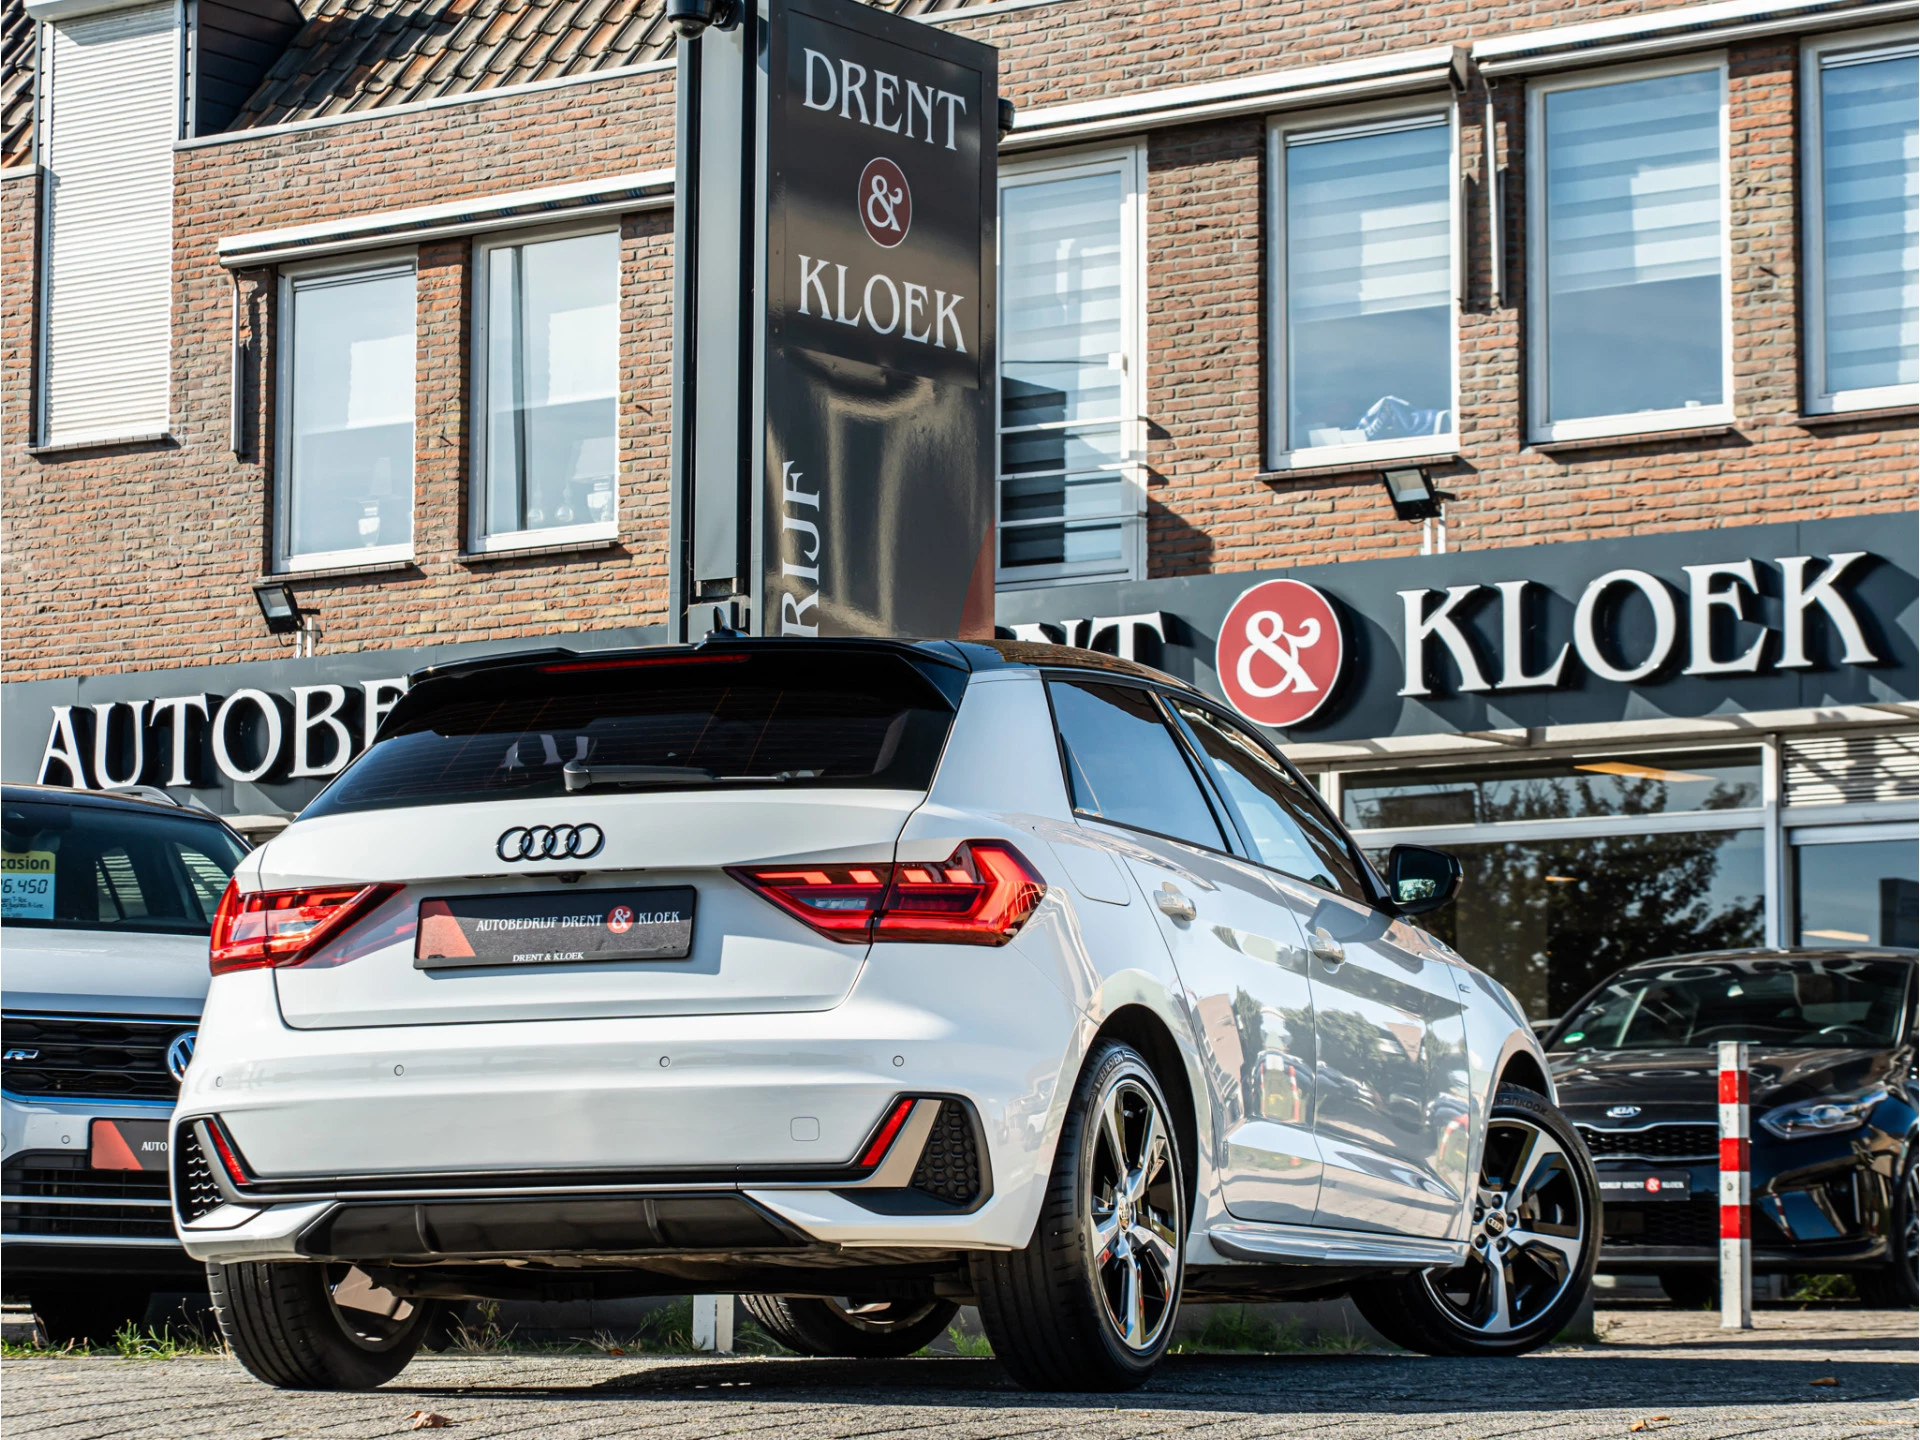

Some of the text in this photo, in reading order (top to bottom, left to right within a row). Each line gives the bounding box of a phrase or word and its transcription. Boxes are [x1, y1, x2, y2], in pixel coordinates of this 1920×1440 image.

[803, 48, 966, 151] DRENT
[798, 254, 967, 353] KLOEK
[782, 461, 819, 637] RIJF
[1396, 550, 1877, 698] KLOEK
[0, 878, 48, 894] 6.450
[475, 908, 680, 932] AUTOBEDRIJF DRENT & KLOEK
[512, 951, 585, 963] DRENT & KLOEK
